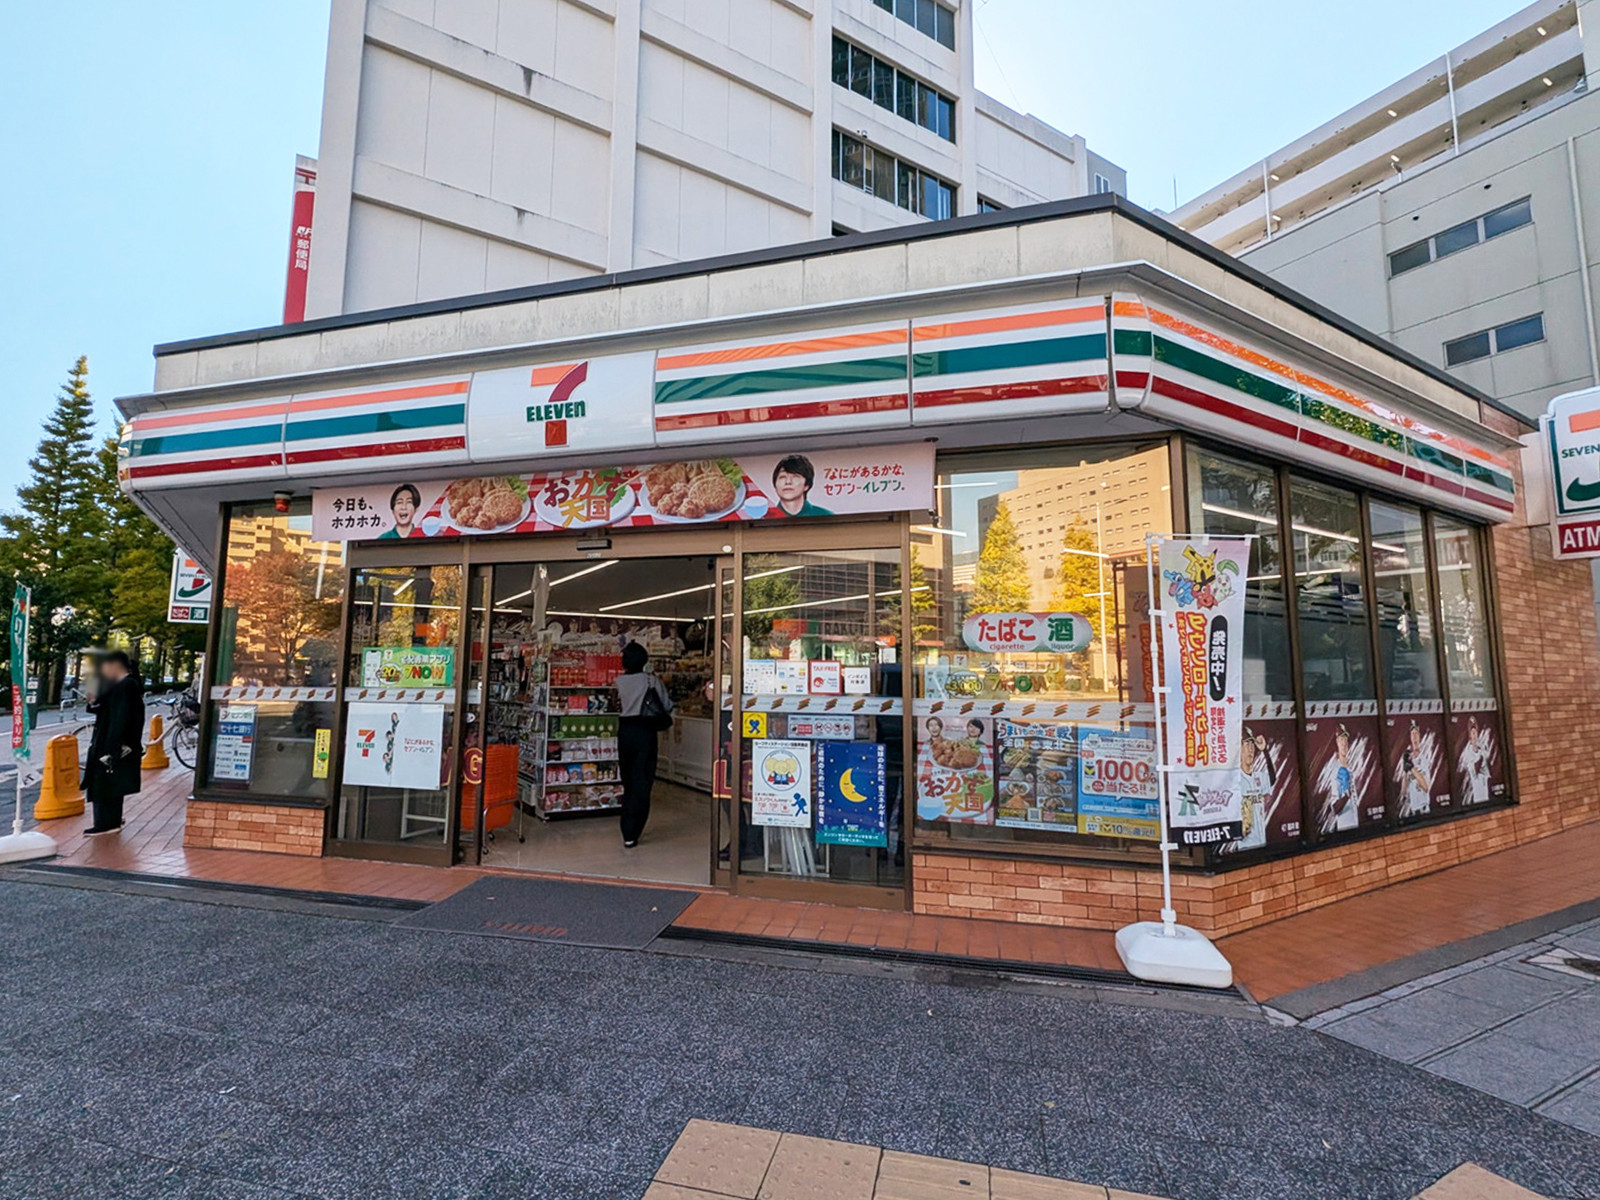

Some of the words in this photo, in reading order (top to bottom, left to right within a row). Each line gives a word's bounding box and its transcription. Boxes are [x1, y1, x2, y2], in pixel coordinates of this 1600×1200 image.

[295, 239, 310, 270] 郵便局
[1561, 443, 1600, 459] SEVEN
[332, 497, 374, 512] 今日も、
[559, 495, 611, 528] 天国
[331, 514, 387, 529] ホカホカ。
[1563, 525, 1600, 549] ATM
[978, 617, 1036, 642] たばこ
[1047, 617, 1074, 642] 酒
[989, 643, 1025, 651] cigarette
[942, 792, 984, 815] 天国
